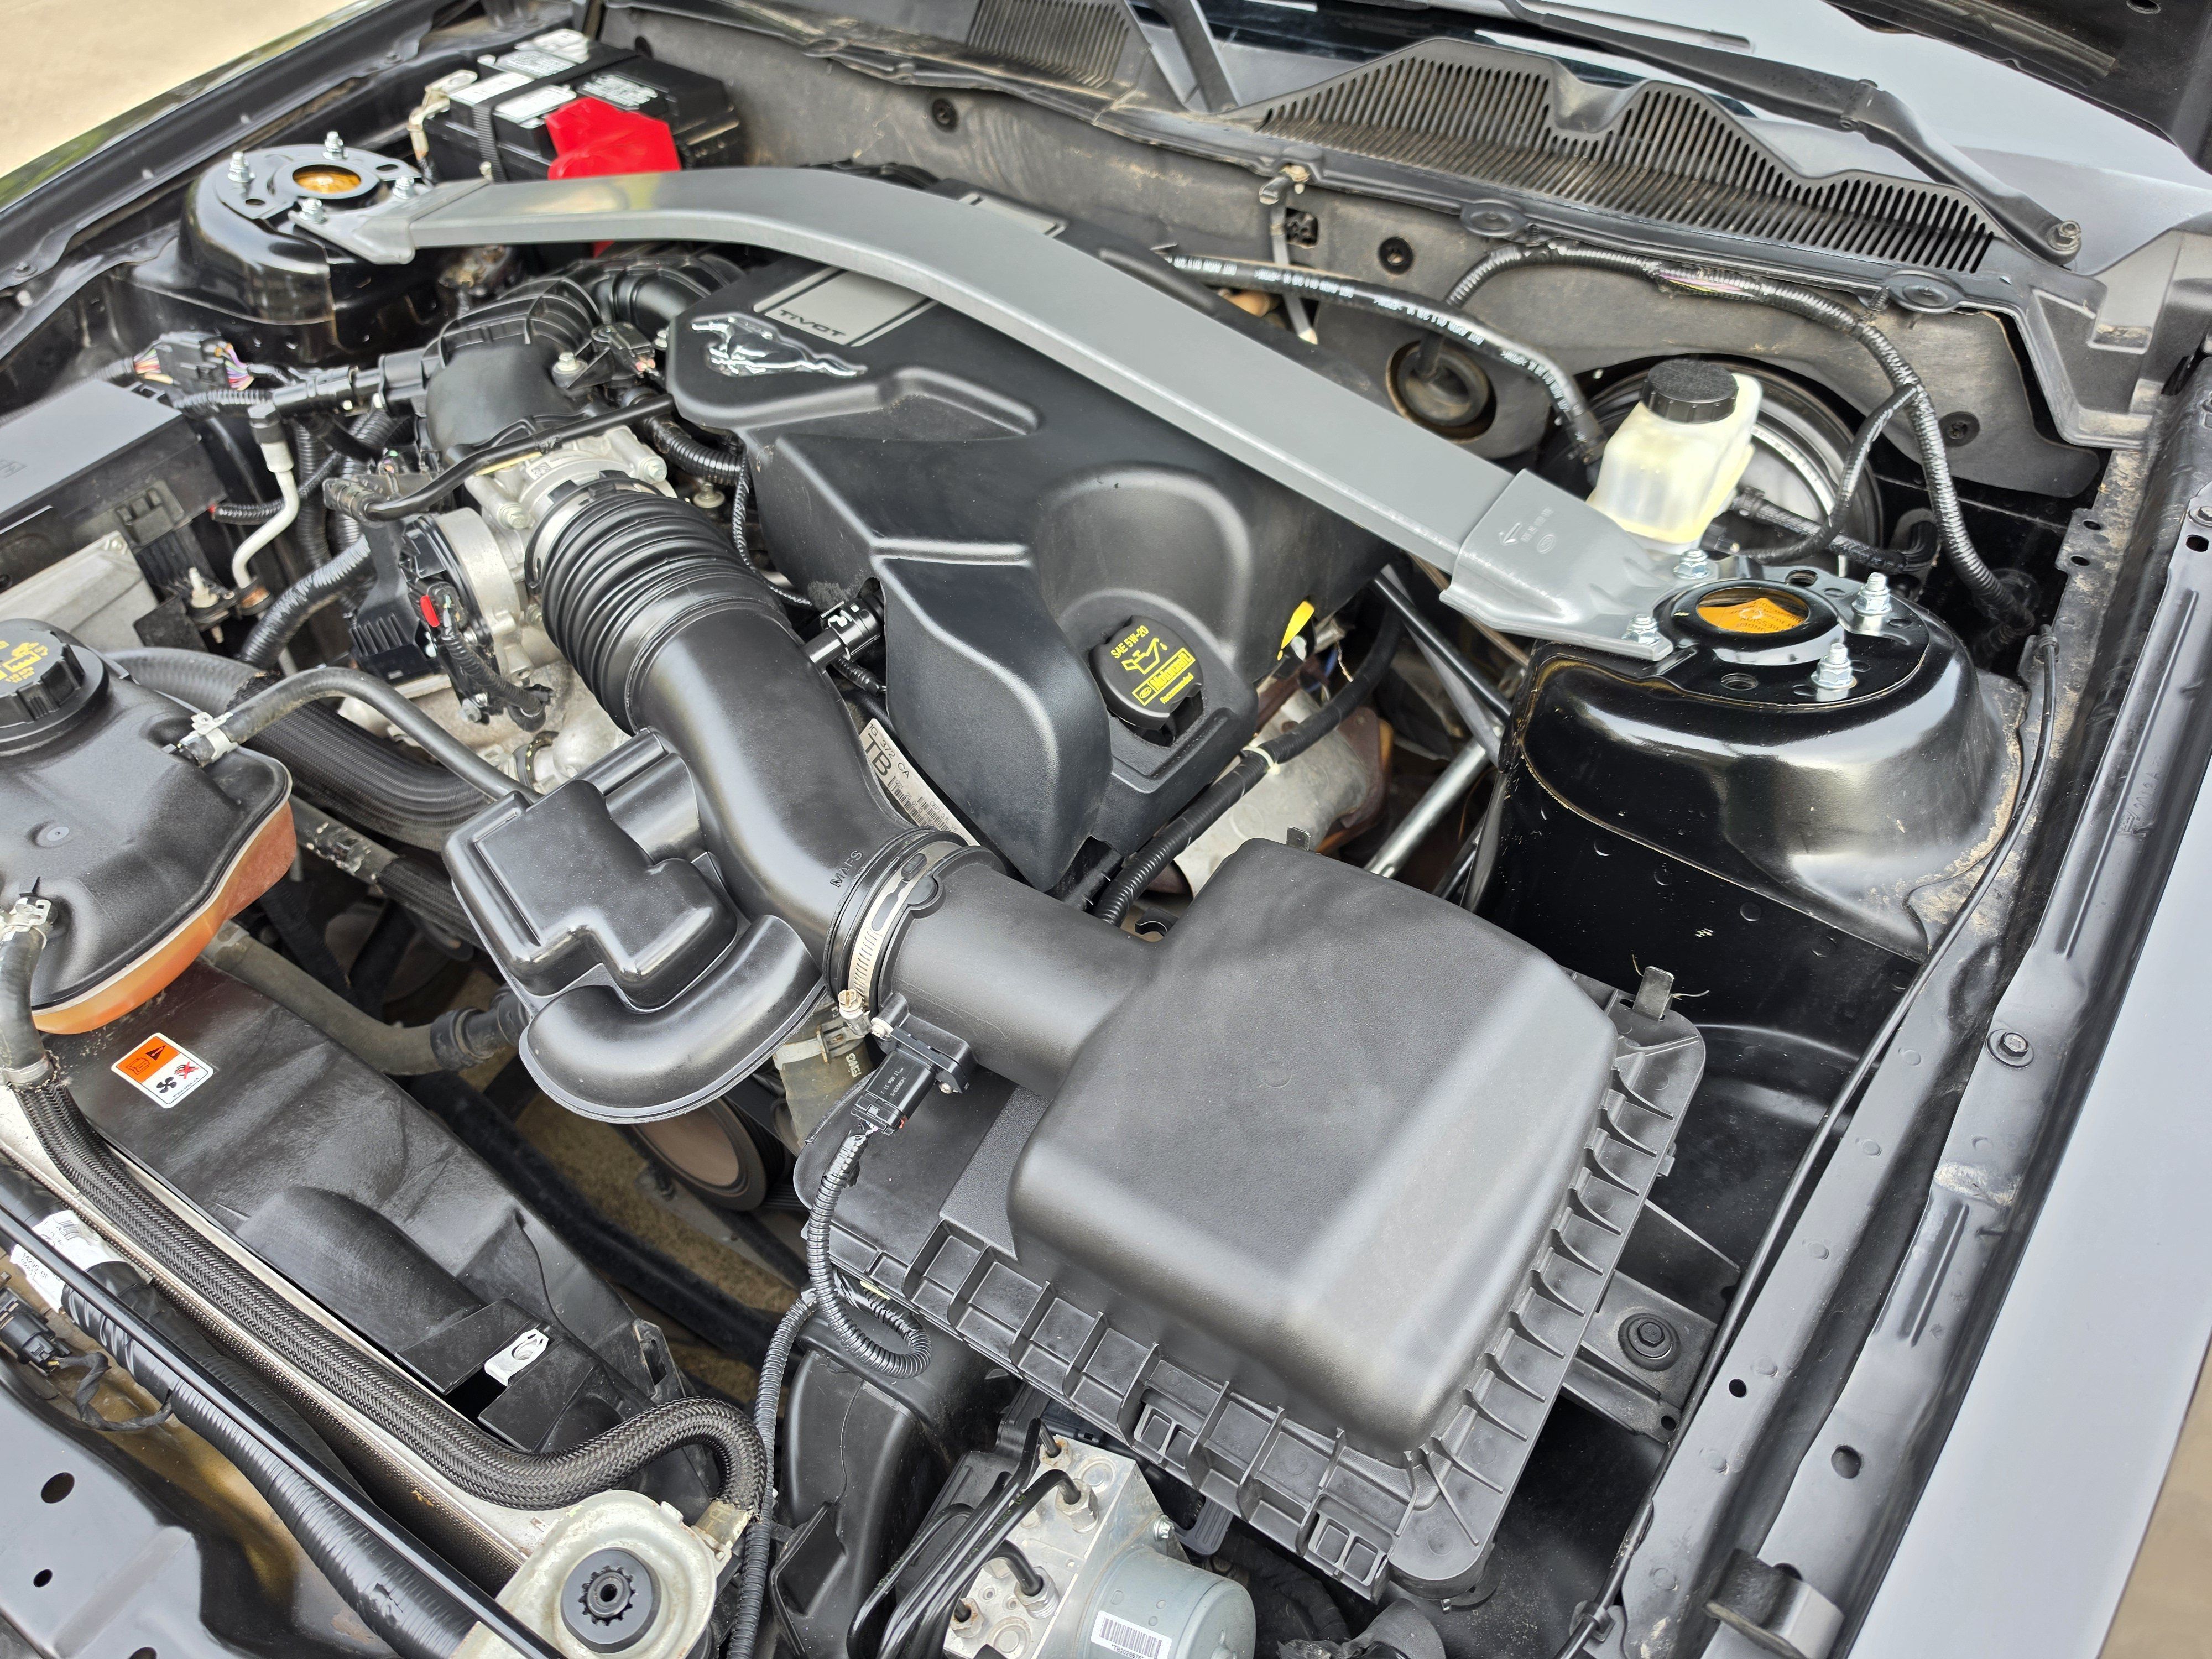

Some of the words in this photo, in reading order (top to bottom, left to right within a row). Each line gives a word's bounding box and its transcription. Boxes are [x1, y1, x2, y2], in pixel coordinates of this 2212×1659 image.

[1110, 643, 1128, 659] SAE
[1123, 625, 1149, 648] 5W-20
[1150, 653, 1192, 690] Motorcraft
[1159, 672, 1194, 704] Recommended
[865, 733, 891, 776] TB
[869, 723, 878, 737] 1G
[880, 740, 895, 759] 372
[897, 762, 910, 779] CA
[905, 792, 911, 800] 25
[941, 813, 950, 824] 3.7L
[830, 851, 863, 888] MAFS
